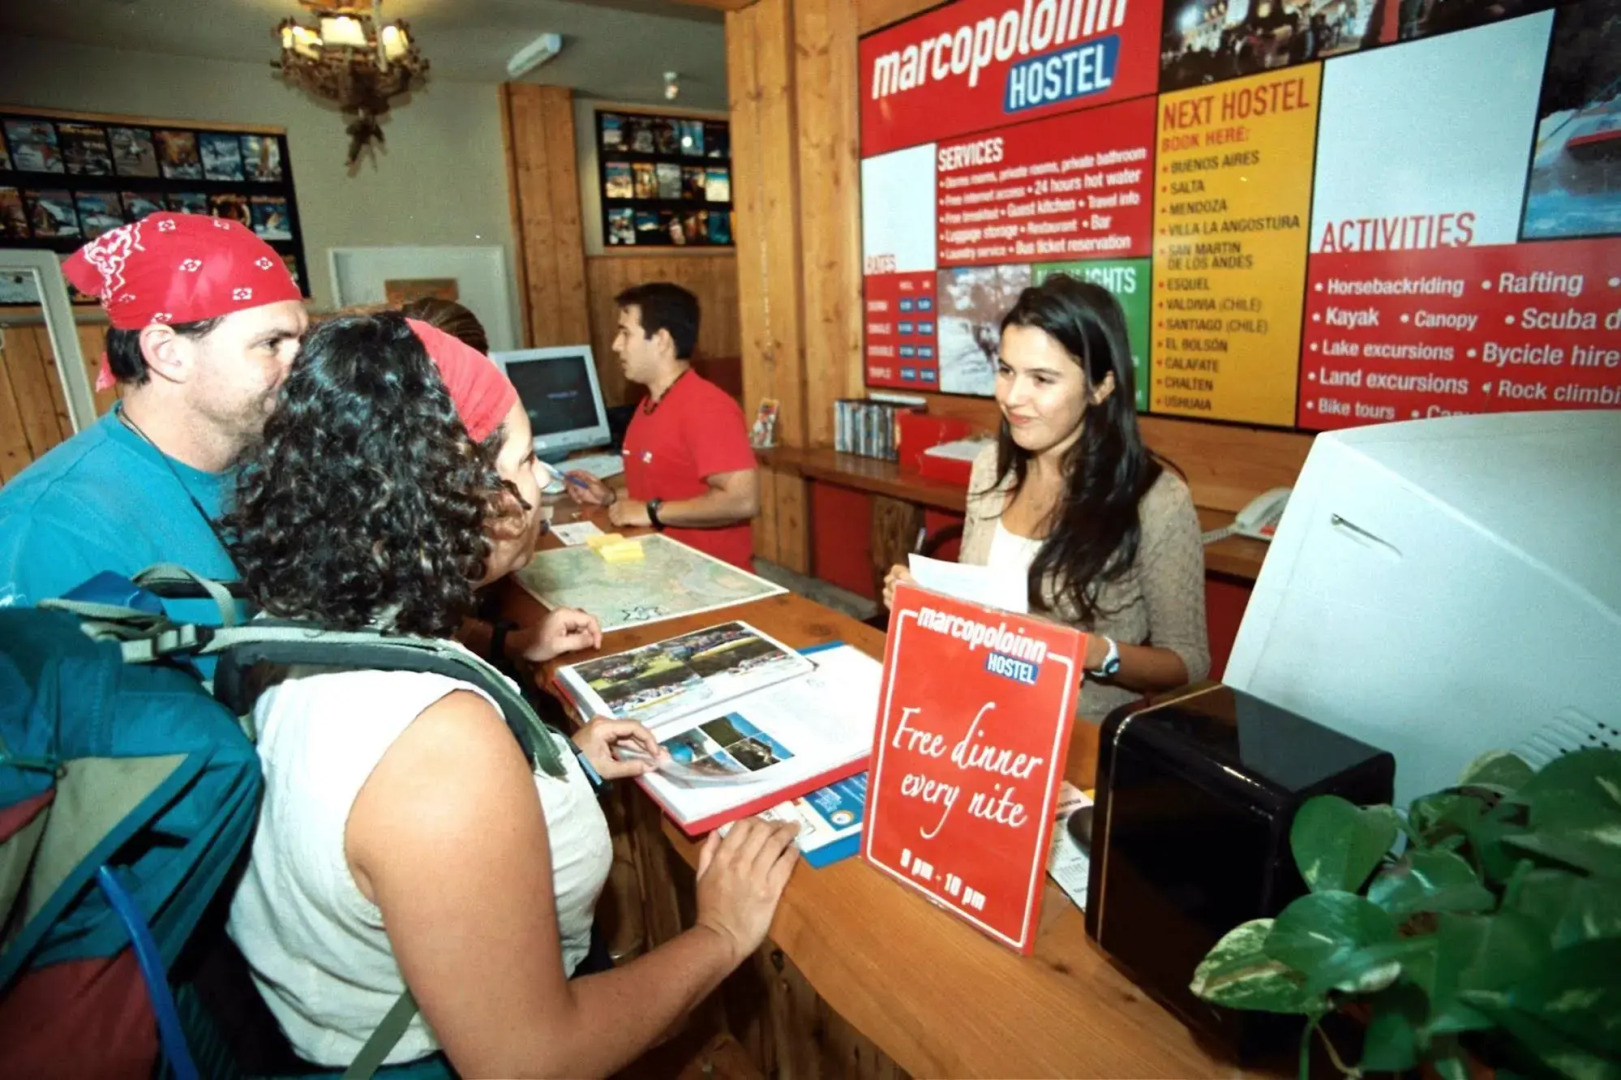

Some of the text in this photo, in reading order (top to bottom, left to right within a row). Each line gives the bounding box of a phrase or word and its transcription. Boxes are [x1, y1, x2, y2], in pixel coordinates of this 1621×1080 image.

[1010, 44, 1111, 109] HOSTEL
[1163, 78, 1310, 131] NEXT HOSTEL
[1162, 126, 1250, 153] BOOK HERE:
[939, 137, 1003, 171] SERVICES
[1170, 150, 1260, 174] BUENOS AIRES
[1034, 180, 1049, 195] 24
[1050, 178, 1082, 192] hours
[1084, 172, 1103, 188] hot
[1105, 169, 1141, 186] water
[1170, 180, 1205, 194] SALTA
[1169, 199, 1227, 216] MENDOZA
[1091, 213, 1112, 230] Bar
[1169, 214, 1300, 237] VILLA LA ANGOSTURA
[1320, 212, 1475, 252] ACTIVITIES
[1067, 235, 1131, 252] reservation
[1168, 244, 1191, 257] SAN
[1168, 255, 1253, 271] DE LOS ANDES
[1167, 278, 1210, 292] ESQUEL
[1328, 271, 1584, 298] Horsebackriding Rafting
[1166, 297, 1262, 314] VALDIVIA (CHILE)
[1166, 318, 1268, 335] SANTIAGO (CHILE)
[1326, 306, 1379, 330] Kayak
[1414, 309, 1478, 331] Canopy
[1521, 307, 1597, 330] Scuba
[1166, 337, 1178, 351] EL
[1322, 339, 1621, 368] Lake excursions Bycicle hire
[1165, 356, 1219, 373] CALAFATE
[1320, 366, 1362, 387] Land
[1366, 372, 1469, 395] excursions
[1498, 379, 1547, 399] Rock
[1164, 395, 1212, 412] USHUAIA
[1318, 397, 1395, 419] Bike tours
[917, 606, 1047, 664] marcopoloinn
[987, 652, 1036, 685] HOSTEL
[892, 701, 1044, 779] Free dinner
[901, 773, 960, 839] every
[967, 783, 1028, 828] nite
[911, 857, 934, 882] pm
[944, 872, 962, 897] 10
[961, 886, 986, 911] pm
